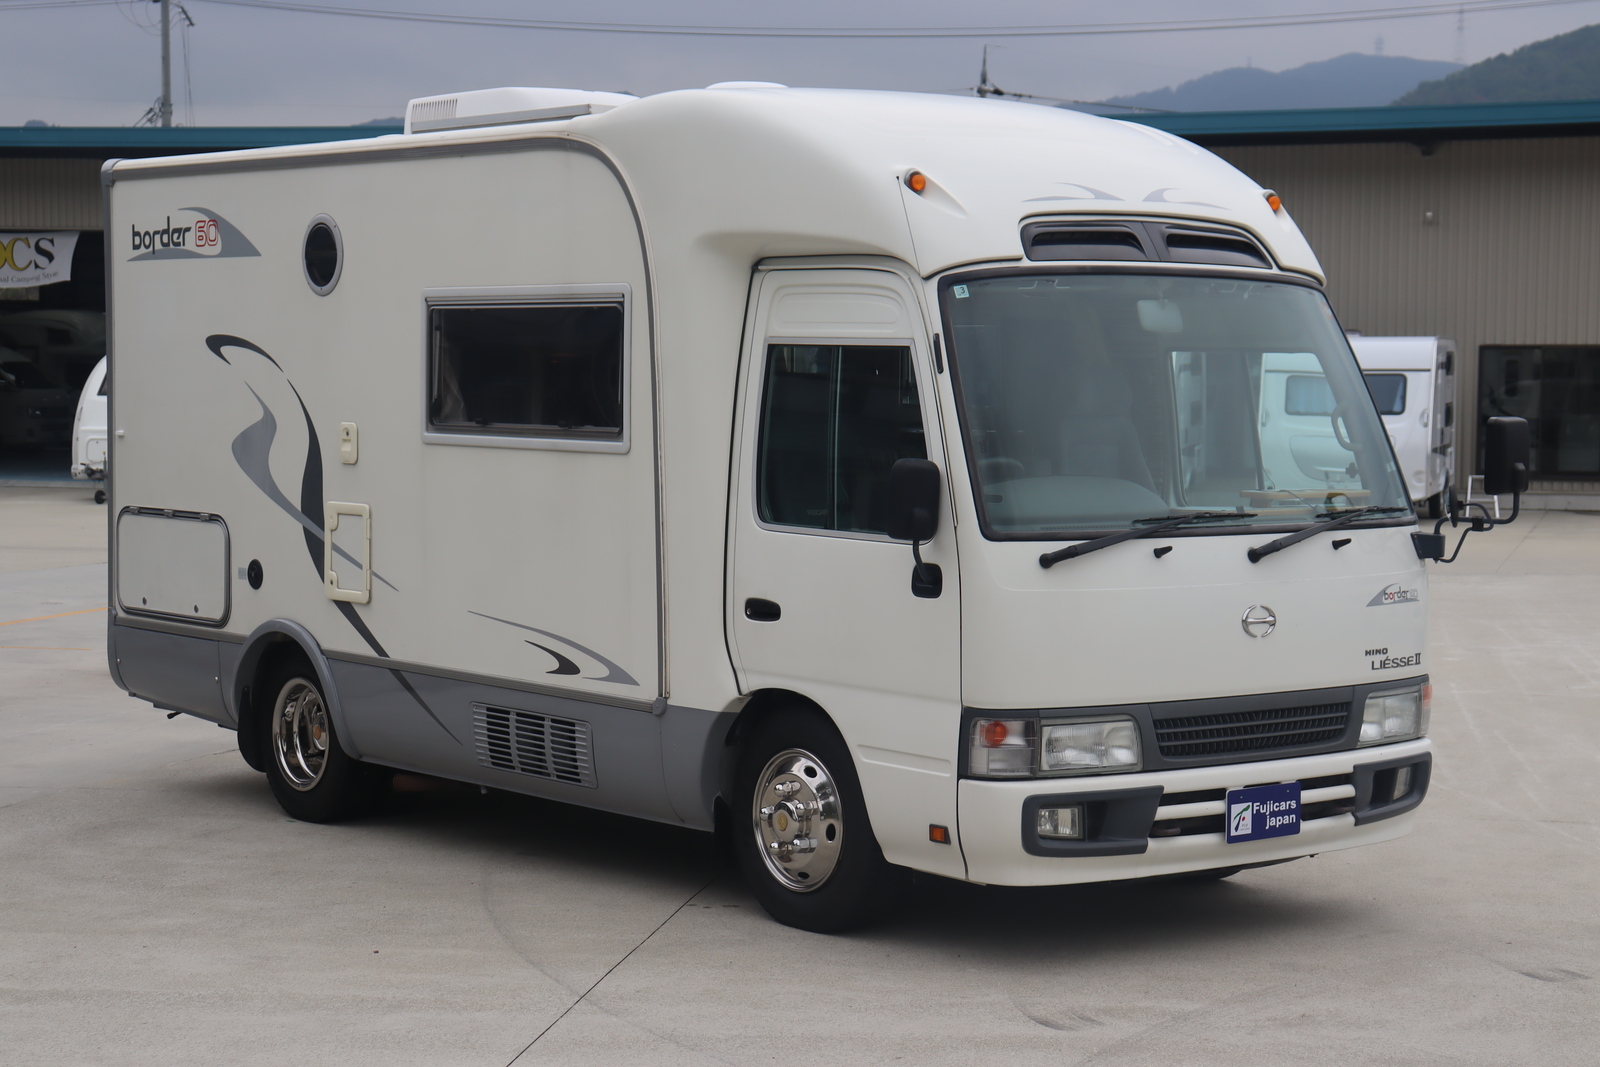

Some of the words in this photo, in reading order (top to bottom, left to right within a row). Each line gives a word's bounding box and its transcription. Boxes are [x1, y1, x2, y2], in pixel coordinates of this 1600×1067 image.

[132, 215, 192, 255] border
[195, 219, 219, 247] 60
[0, 237, 55, 271] CS
[959, 286, 966, 294] 3
[1383, 586, 1409, 602] border
[1364, 647, 1389, 656] HINO
[1253, 800, 1297, 815] Fujicars
[1265, 814, 1296, 830] japan
